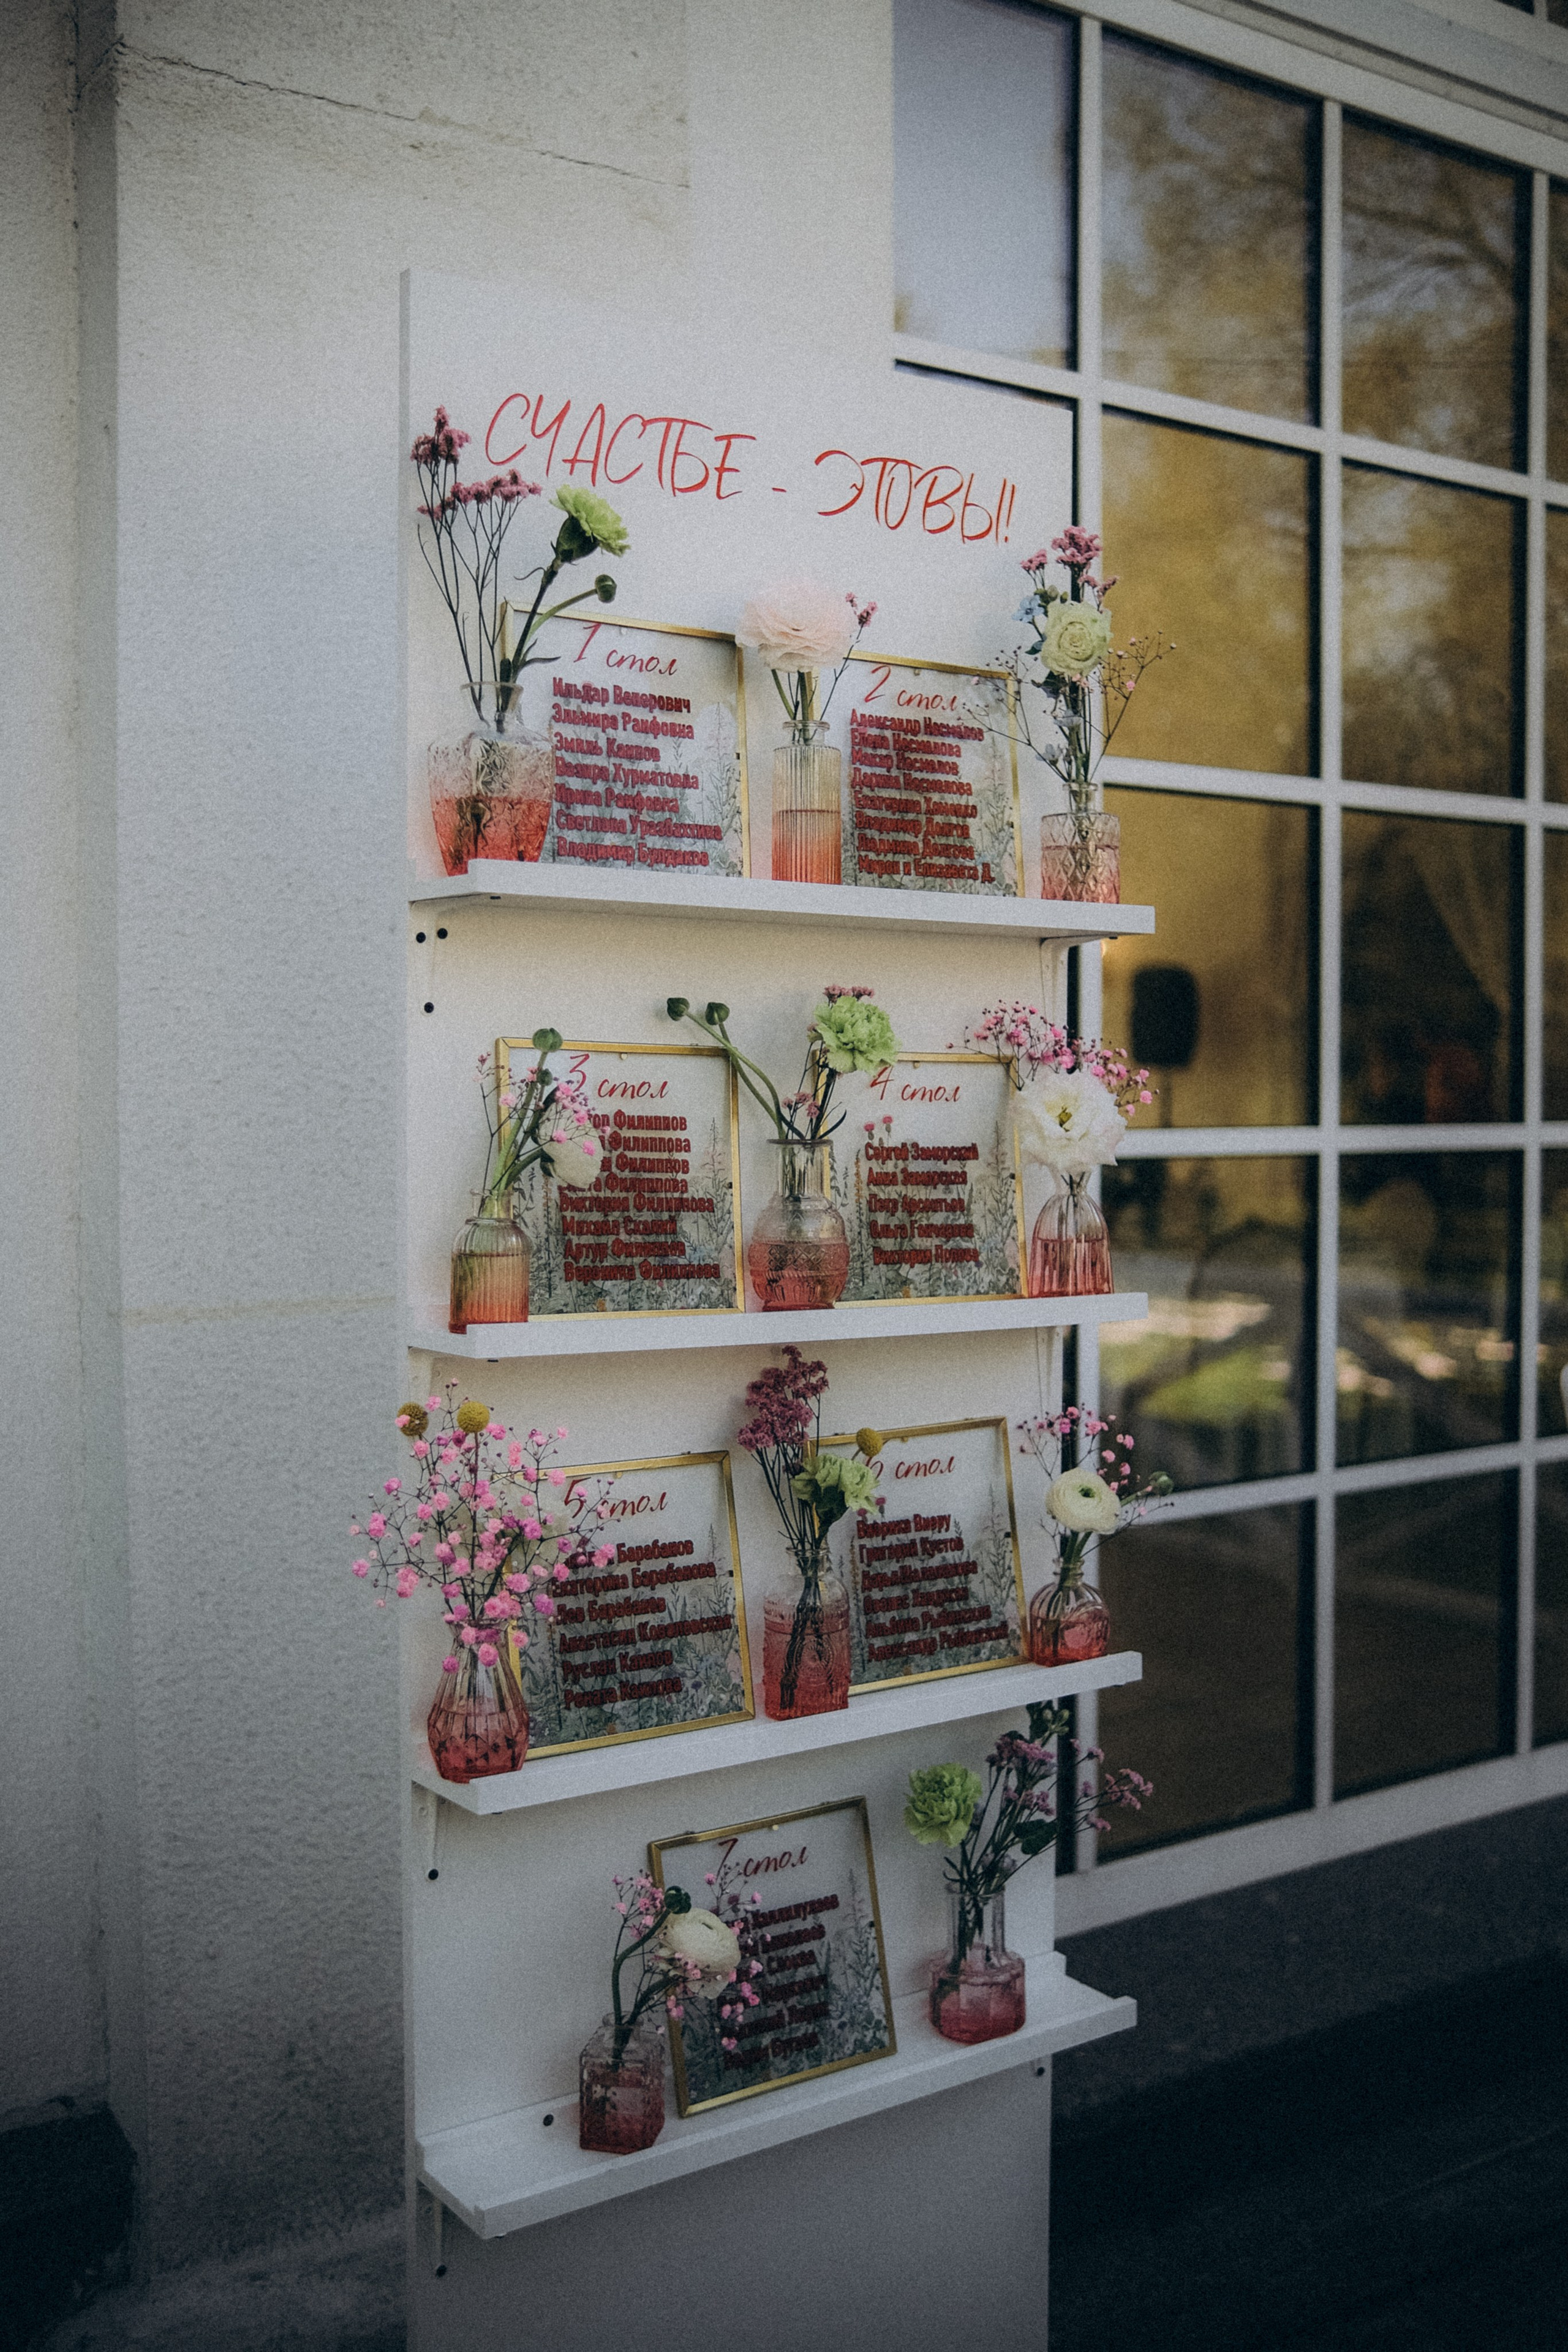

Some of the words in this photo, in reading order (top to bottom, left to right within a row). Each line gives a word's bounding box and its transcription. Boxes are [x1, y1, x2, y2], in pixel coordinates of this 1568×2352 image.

[485, 393, 756, 500] СЧАСТЬЕ
[573, 622, 601, 663] 1
[606, 649, 677, 676] стол
[552, 677, 609, 706] Ильдар
[613, 684, 691, 713] Венерович
[864, 665, 891, 703] 2
[897, 690, 957, 711] стол
[552, 703, 619, 732] Эльмира
[622, 712, 695, 739] Раифовна
[850, 708, 921, 735] Александр
[554, 733, 603, 756] Эмиль
[606, 737, 660, 762] Каипов
[851, 728, 889, 749] Елена
[555, 756, 610, 785] Вазира
[612, 763, 699, 790] Хурматовна
[554, 783, 602, 809] Ирина
[605, 787, 679, 813] Раифовна
[854, 790, 922, 815] Екатерина
[556, 810, 627, 834] Светлана
[630, 815, 723, 841] Уразбахтина
[854, 810, 922, 837] Владимир
[557, 836, 635, 865] Владимир
[638, 843, 709, 867] Булдаков
[856, 833, 919, 856] Людмила
[858, 854, 900, 878] Мирон
[903, 862, 911, 875] и
[915, 858, 979, 880] Елизавета
[570, 1053, 590, 1093] 3
[598, 1079, 669, 1099] стол
[870, 1065, 894, 1101] 4
[901, 1084, 960, 1102] стол
[613, 1109, 687, 1131] Филиппов
[608, 1130, 691, 1153] Филиппова
[865, 1142, 909, 1164] Сергей
[616, 1152, 690, 1174] Филиппов
[605, 1172, 688, 1194] Филиппова
[559, 1193, 630, 1216] Виктория
[633, 1193, 714, 1213] Филиппова
[562, 1216, 620, 1236] Михаил
[870, 1219, 908, 1239] Ольга
[564, 1238, 608, 1264] Артур
[612, 1237, 685, 1256] Филиппов
[564, 1261, 636, 1286] Вероника
[639, 1259, 721, 1281] Филиппова
[895, 1456, 956, 1479] стол
[564, 1477, 592, 1518] 5
[616, 1539, 693, 1565] Барабанов
[550, 1572, 629, 1597] Екатерина
[631, 1561, 717, 1591] Барабанова
[556, 1604, 585, 1626] Лев
[587, 1596, 666, 1623] Барабанов
[559, 1628, 637, 1654] Анастасия
[562, 1658, 616, 1683] Руслан
[716, 1838, 738, 1881] 7
[744, 1846, 809, 1877] стол
